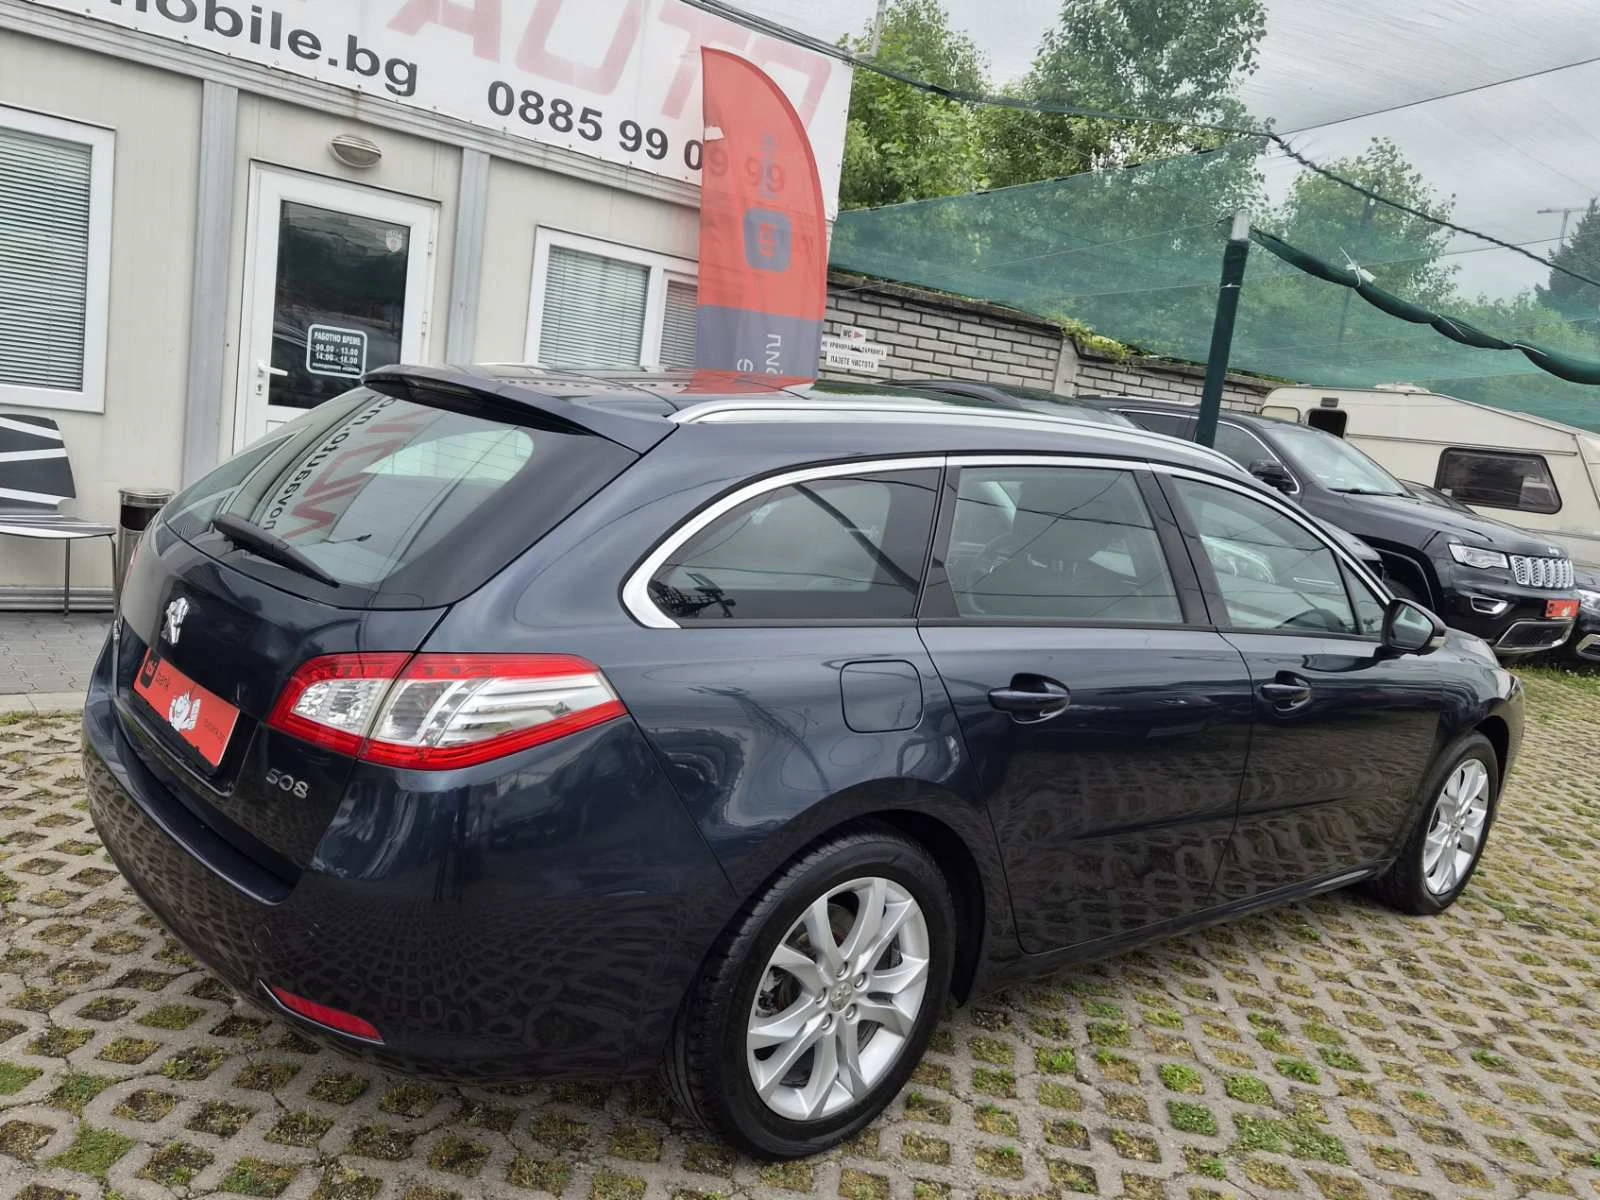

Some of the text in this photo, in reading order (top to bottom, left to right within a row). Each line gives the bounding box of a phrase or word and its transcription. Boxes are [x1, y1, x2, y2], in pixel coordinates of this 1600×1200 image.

[487, 80, 604, 142] 0885
[618, 119, 669, 161] 99
[314, 331, 361, 345] РАБОТНО ВРЕМЕ
[265, 766, 310, 800] 508
